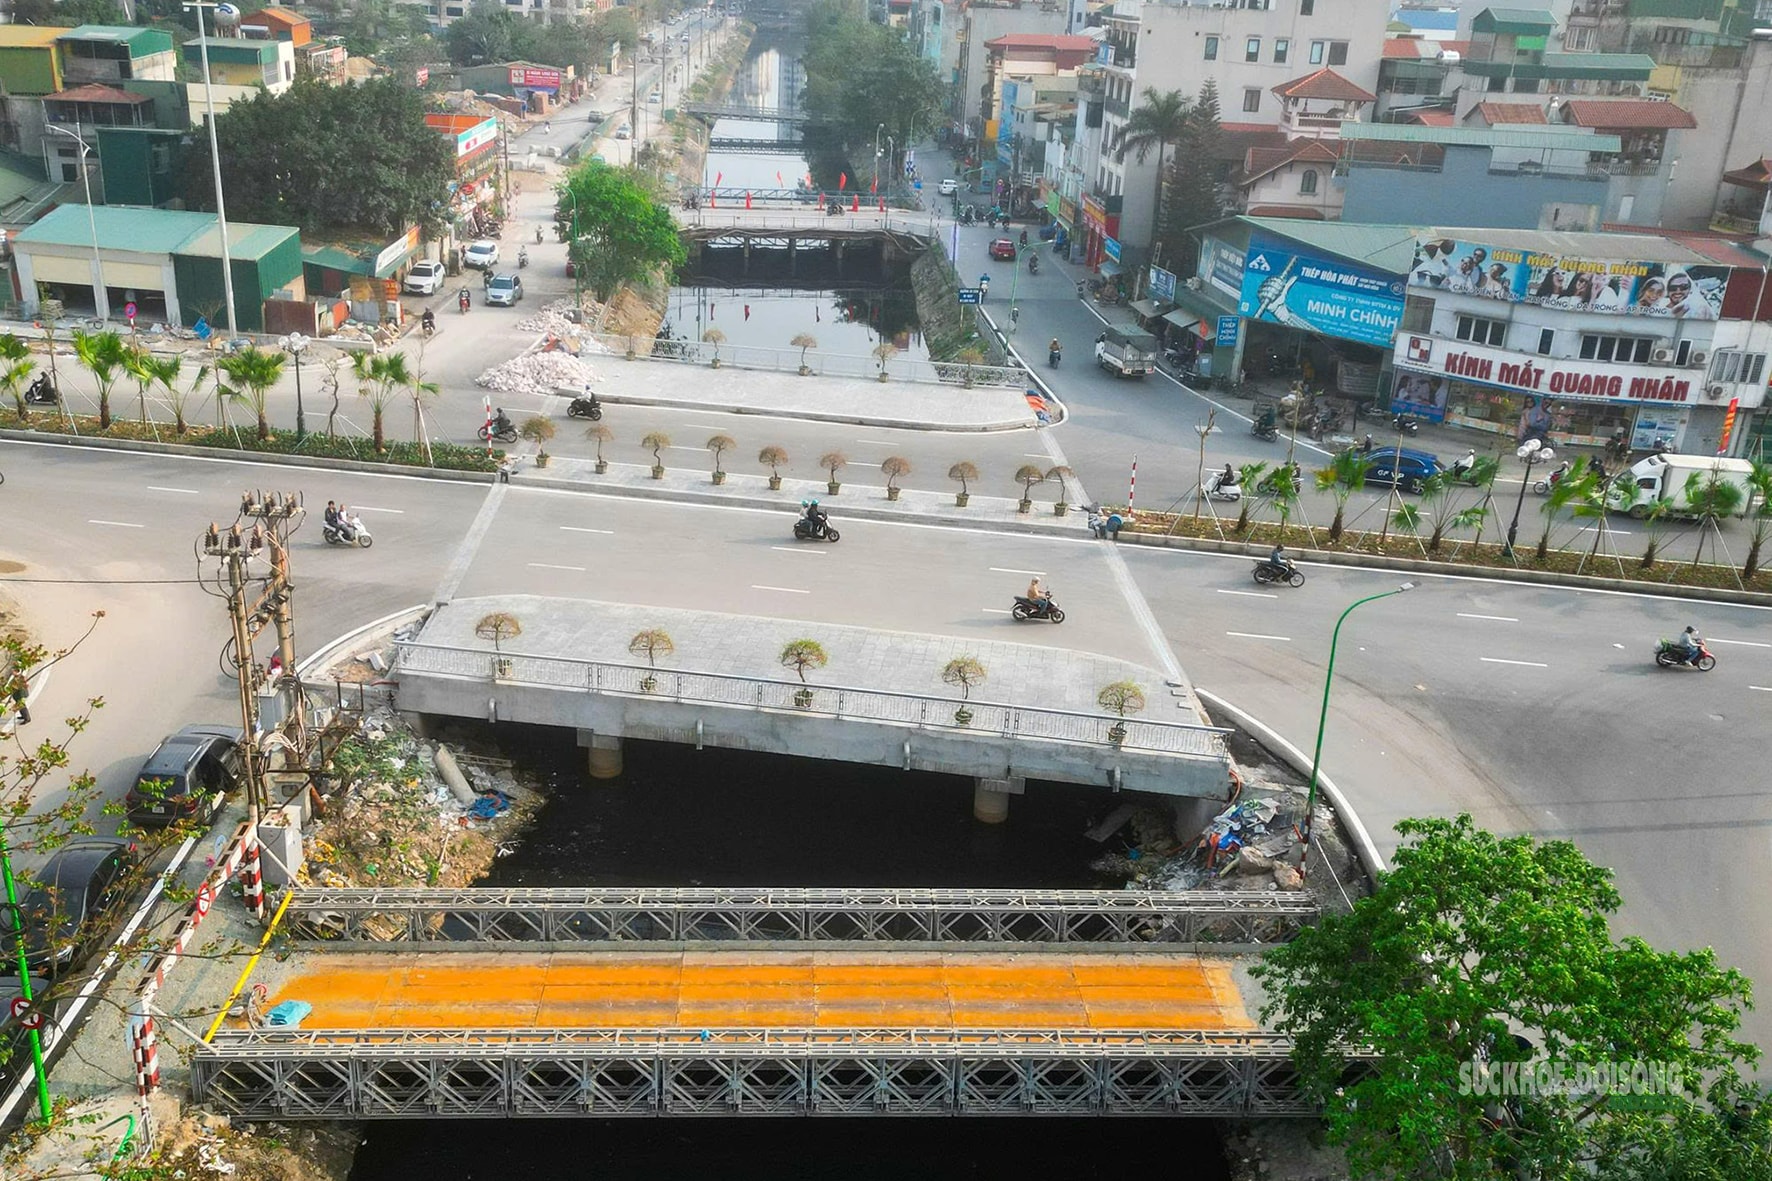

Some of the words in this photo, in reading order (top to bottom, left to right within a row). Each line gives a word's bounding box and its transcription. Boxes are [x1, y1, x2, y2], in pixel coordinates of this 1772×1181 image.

[1301, 266, 1321, 278] THÉP
[1320, 269, 1338, 283] HÒA
[1337, 272, 1359, 286] PHÁT
[1307, 300, 1347, 319] MINH
[1350, 309, 1398, 328] CHÍNH
[1444, 351, 1493, 380] KÍNH
[1498, 359, 1545, 390] MẮT
[1549, 371, 1623, 396] QUANG
